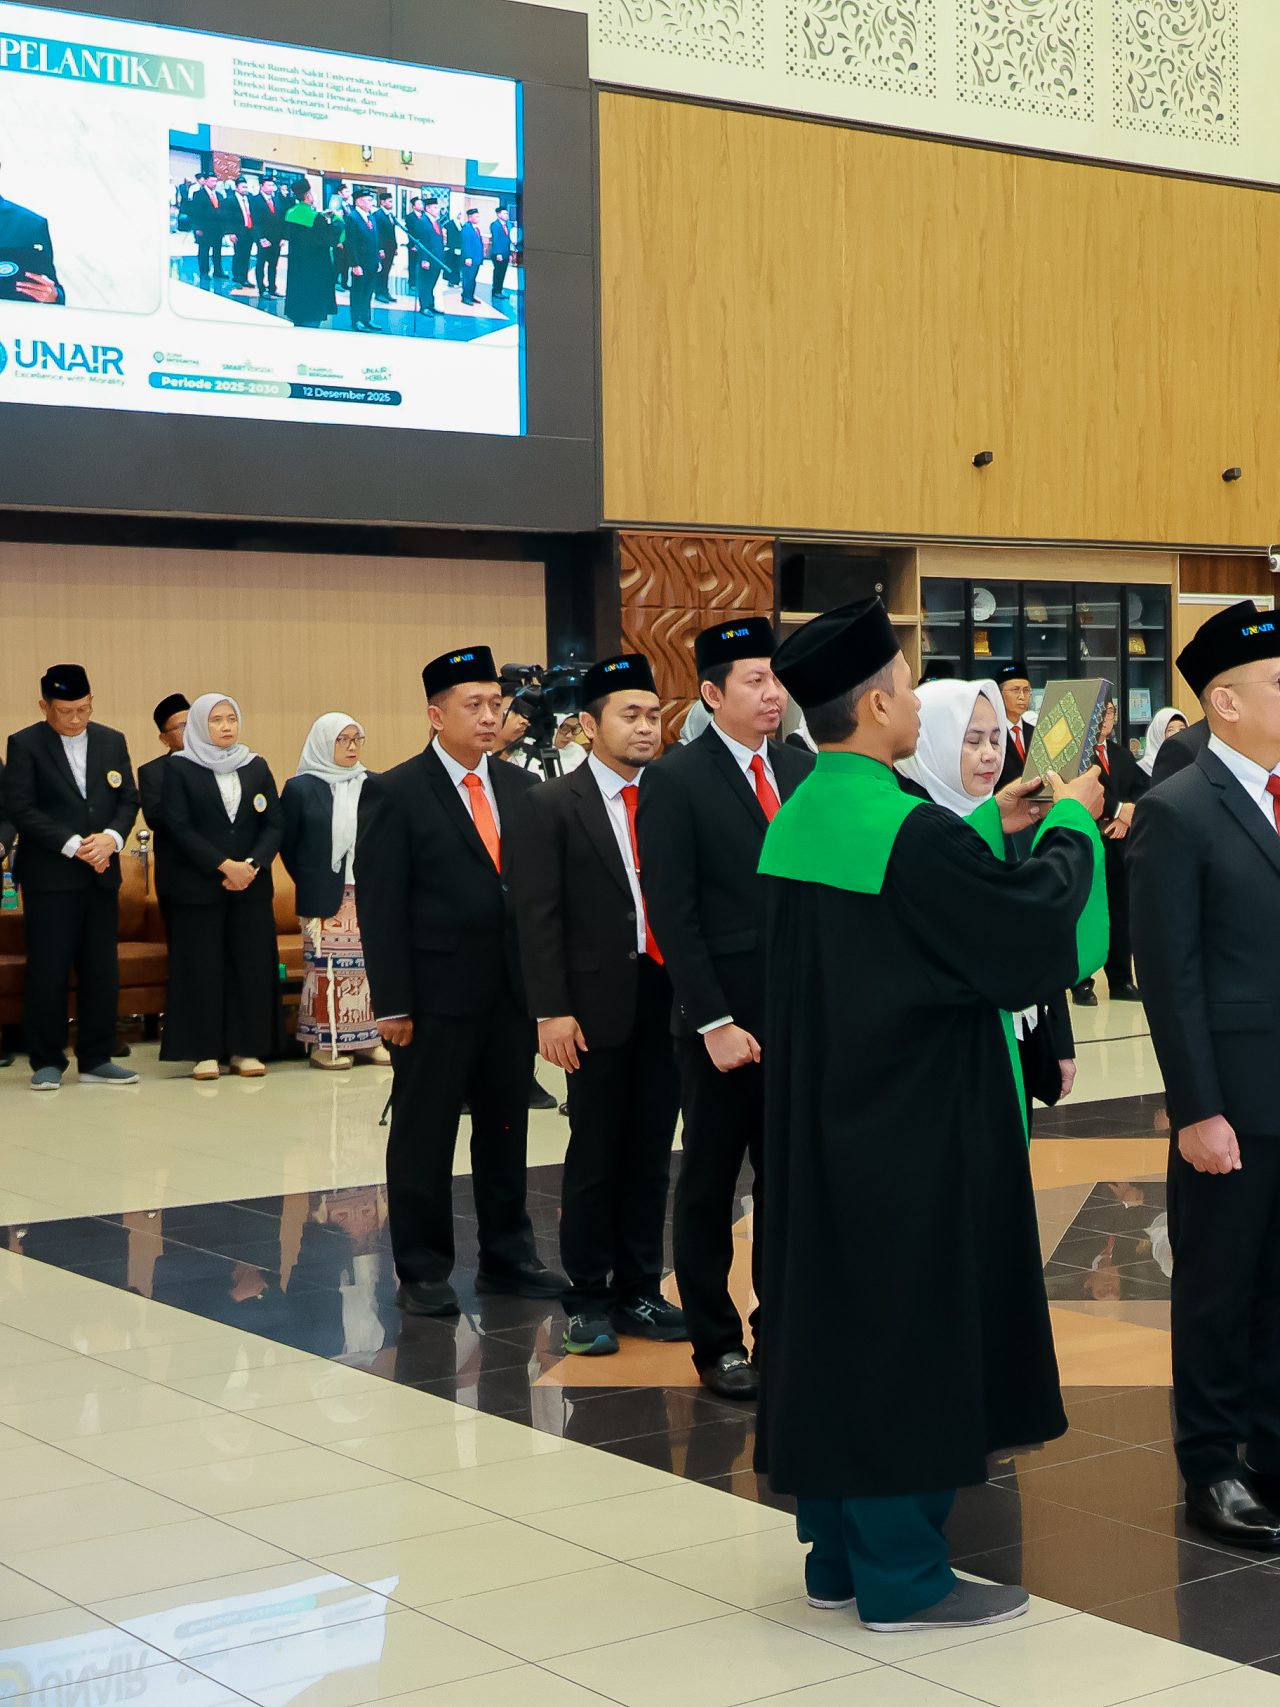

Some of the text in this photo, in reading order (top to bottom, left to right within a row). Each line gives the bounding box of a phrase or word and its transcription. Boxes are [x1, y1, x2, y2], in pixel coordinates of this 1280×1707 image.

[0, 37, 196, 93] PELANTIKAN
[15, 339, 125, 375] UNAIR
[162, 376, 279, 394] Periode 2025-2030
[303, 386, 391, 402] 12 Desember 2025
